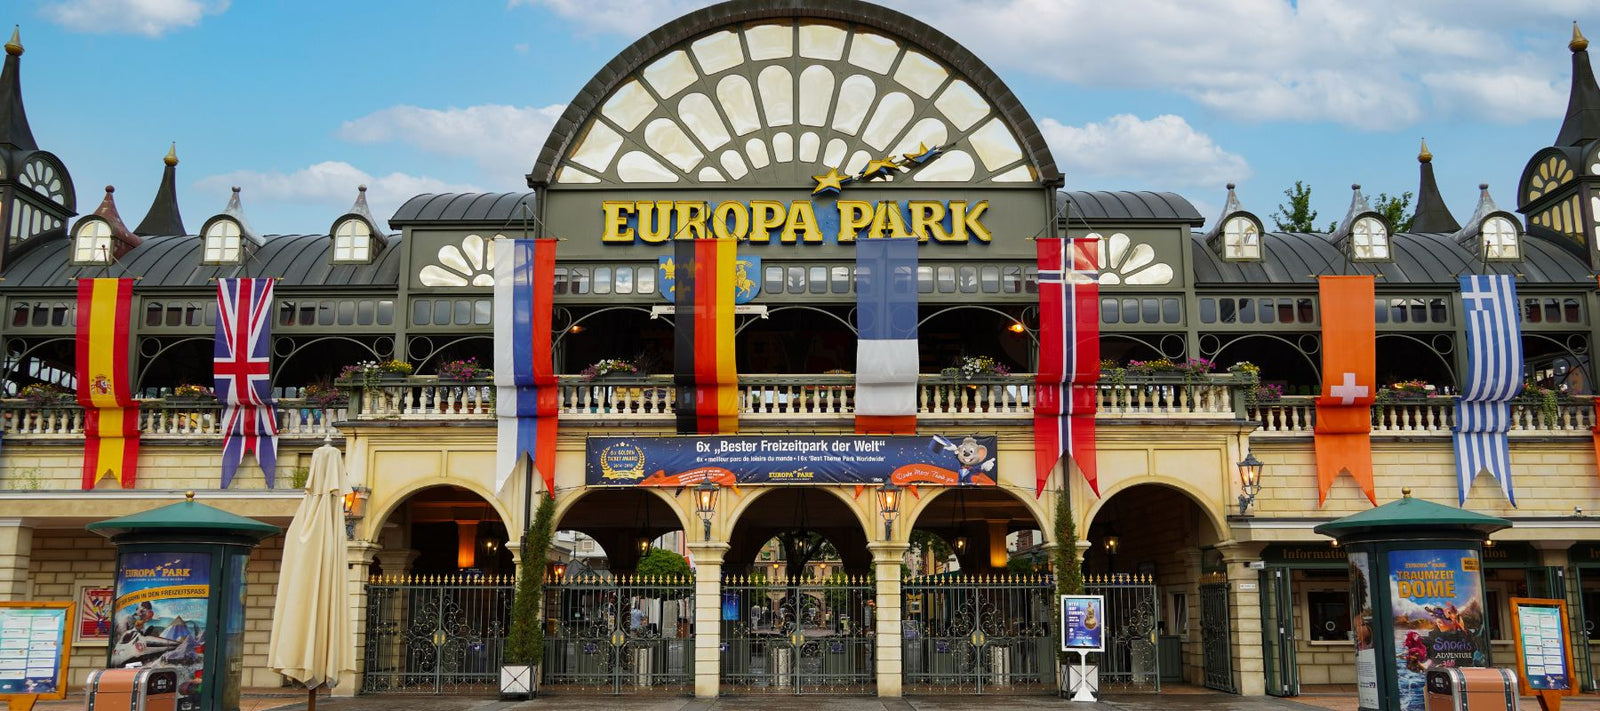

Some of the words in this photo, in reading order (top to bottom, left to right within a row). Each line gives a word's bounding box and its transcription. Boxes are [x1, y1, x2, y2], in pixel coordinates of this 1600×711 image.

[602, 200, 823, 243] EUROPA
[837, 200, 992, 243] PARK
[696, 441, 711, 453] 6x
[761, 439, 828, 453] Freizeitpark
[831, 440, 851, 452] der
[125, 568, 156, 578] EUROPA
[162, 568, 191, 577] PARK
[1397, 570, 1455, 580] TRAUMZEIT
[161, 588, 206, 596] FREIZEITSPASS
[1397, 580, 1457, 598] DOME
